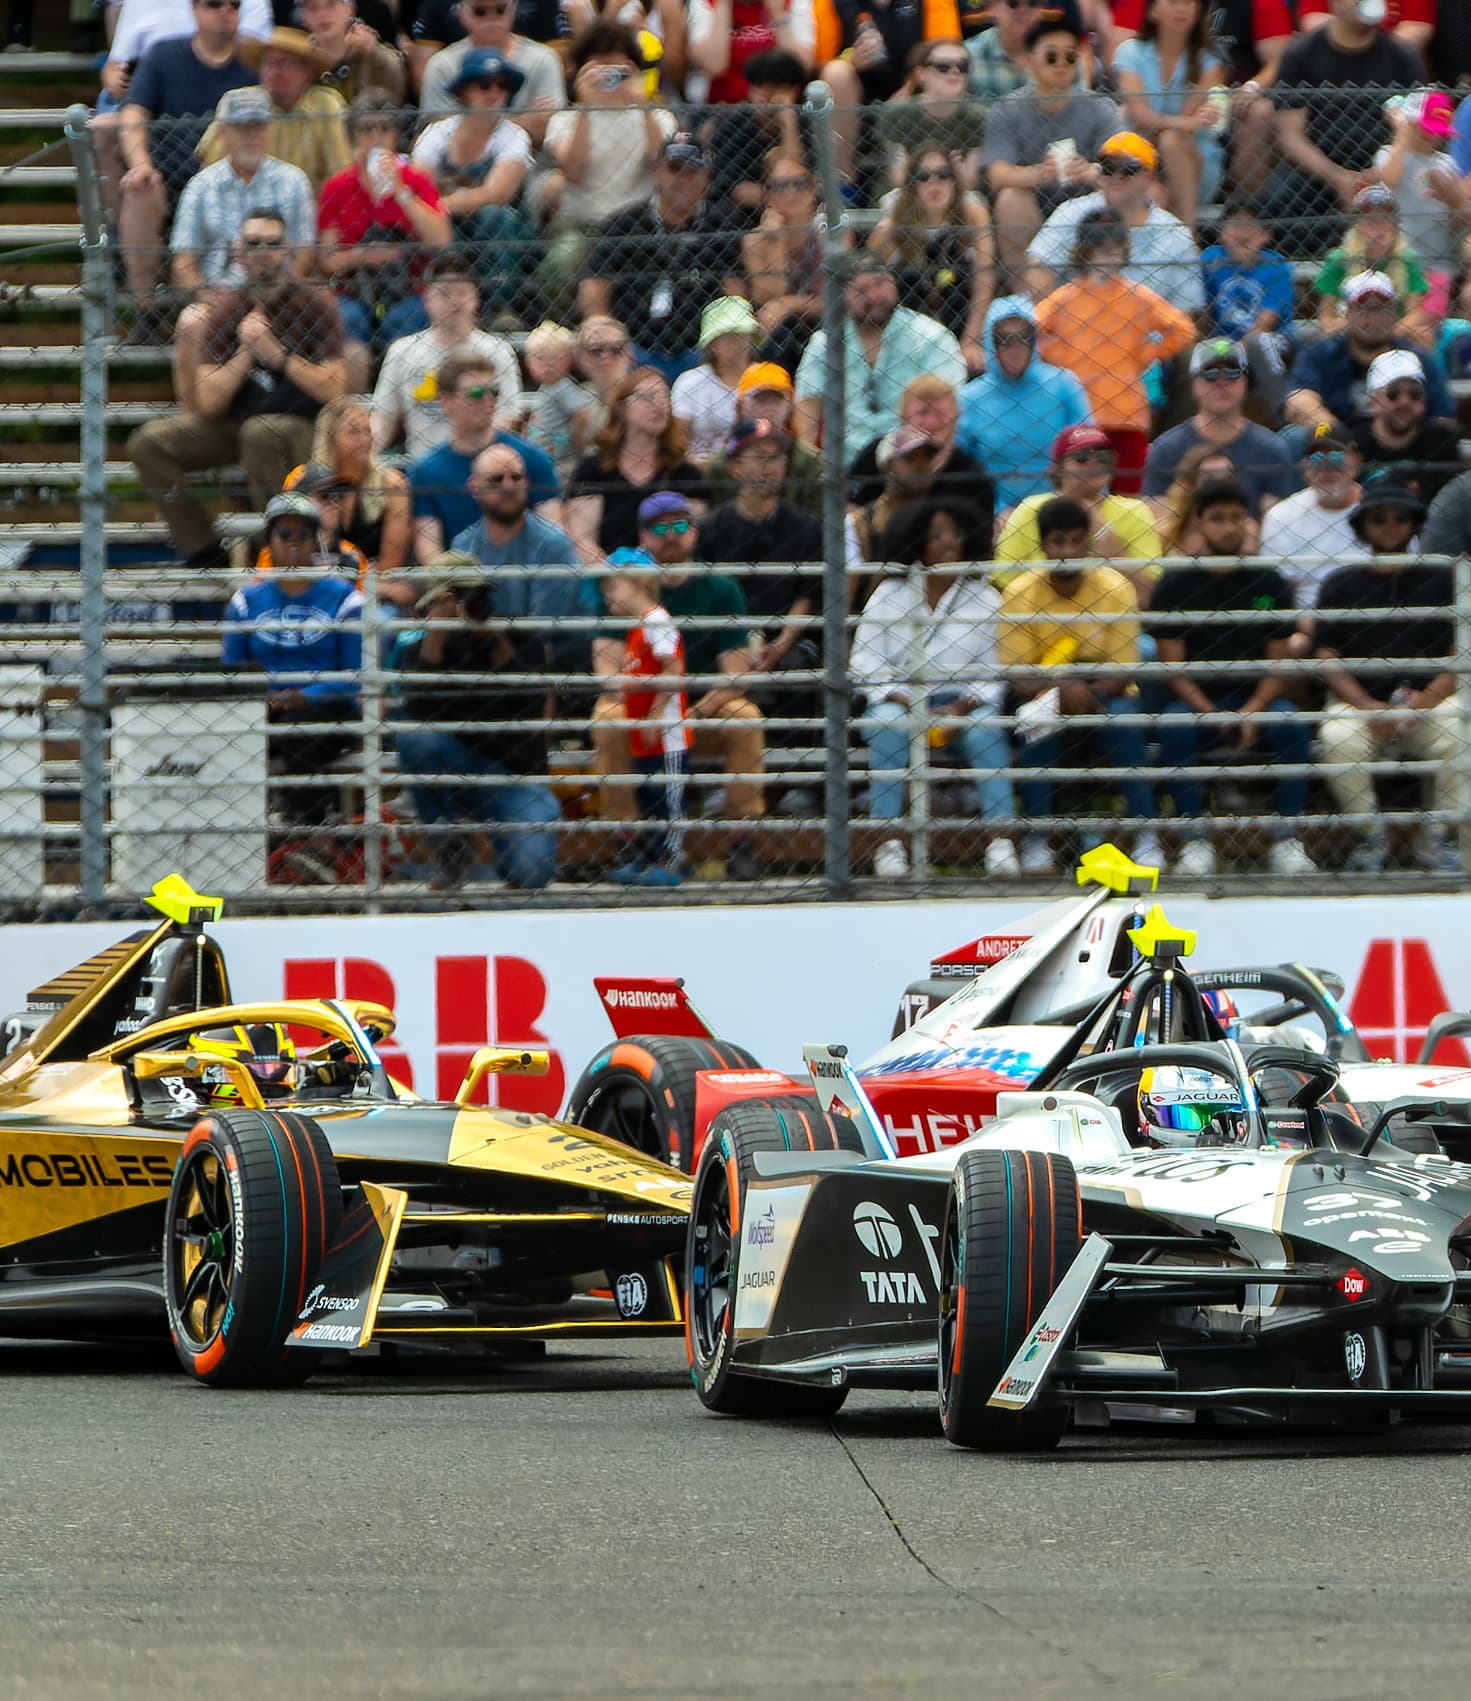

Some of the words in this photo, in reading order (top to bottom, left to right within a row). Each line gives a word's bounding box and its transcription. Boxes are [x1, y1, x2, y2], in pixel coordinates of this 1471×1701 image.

[282, 955, 568, 1122] BB
[1172, 1092, 1240, 1102] JAGUAR
[740, 1271, 776, 1290] JAGUAR
[860, 1271, 928, 1305] TATA
